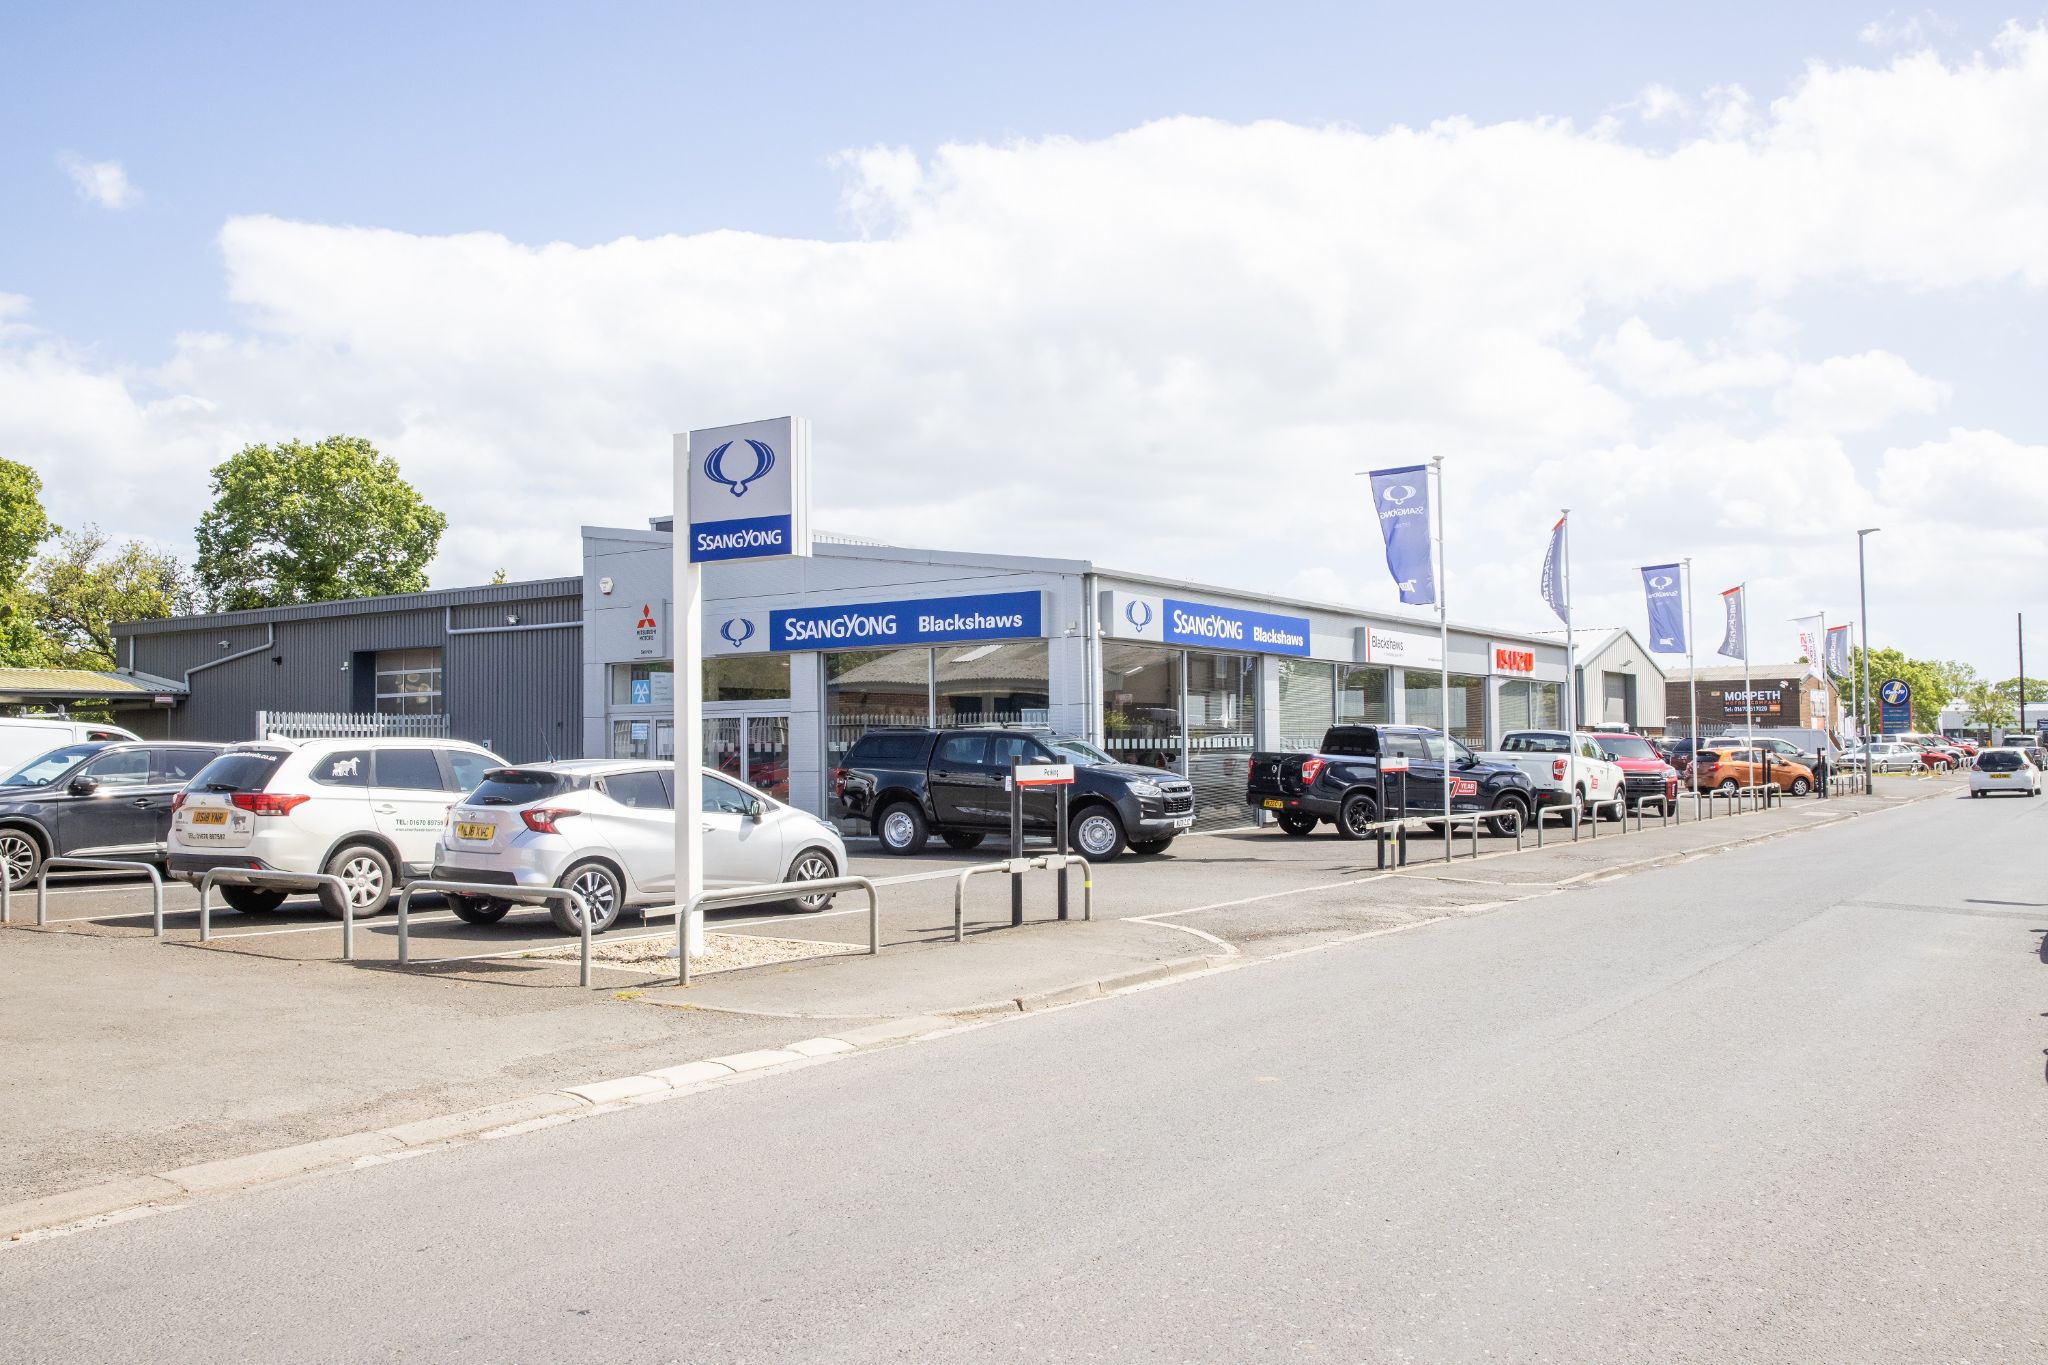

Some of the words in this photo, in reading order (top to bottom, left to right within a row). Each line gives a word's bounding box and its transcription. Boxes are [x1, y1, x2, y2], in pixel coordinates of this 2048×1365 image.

[697, 529, 782, 551] SSANGYONG
[785, 613, 897, 641] SSANGYONG
[918, 612, 1022, 633] Blackshaws
[1173, 609, 1243, 640] SSANGYONG
[1253, 626, 1304, 647] Blackshaws
[1371, 635, 1404, 651] Blackshaws
[1496, 649, 1533, 672] ISUZU
[1724, 690, 1781, 701] MORPETH
